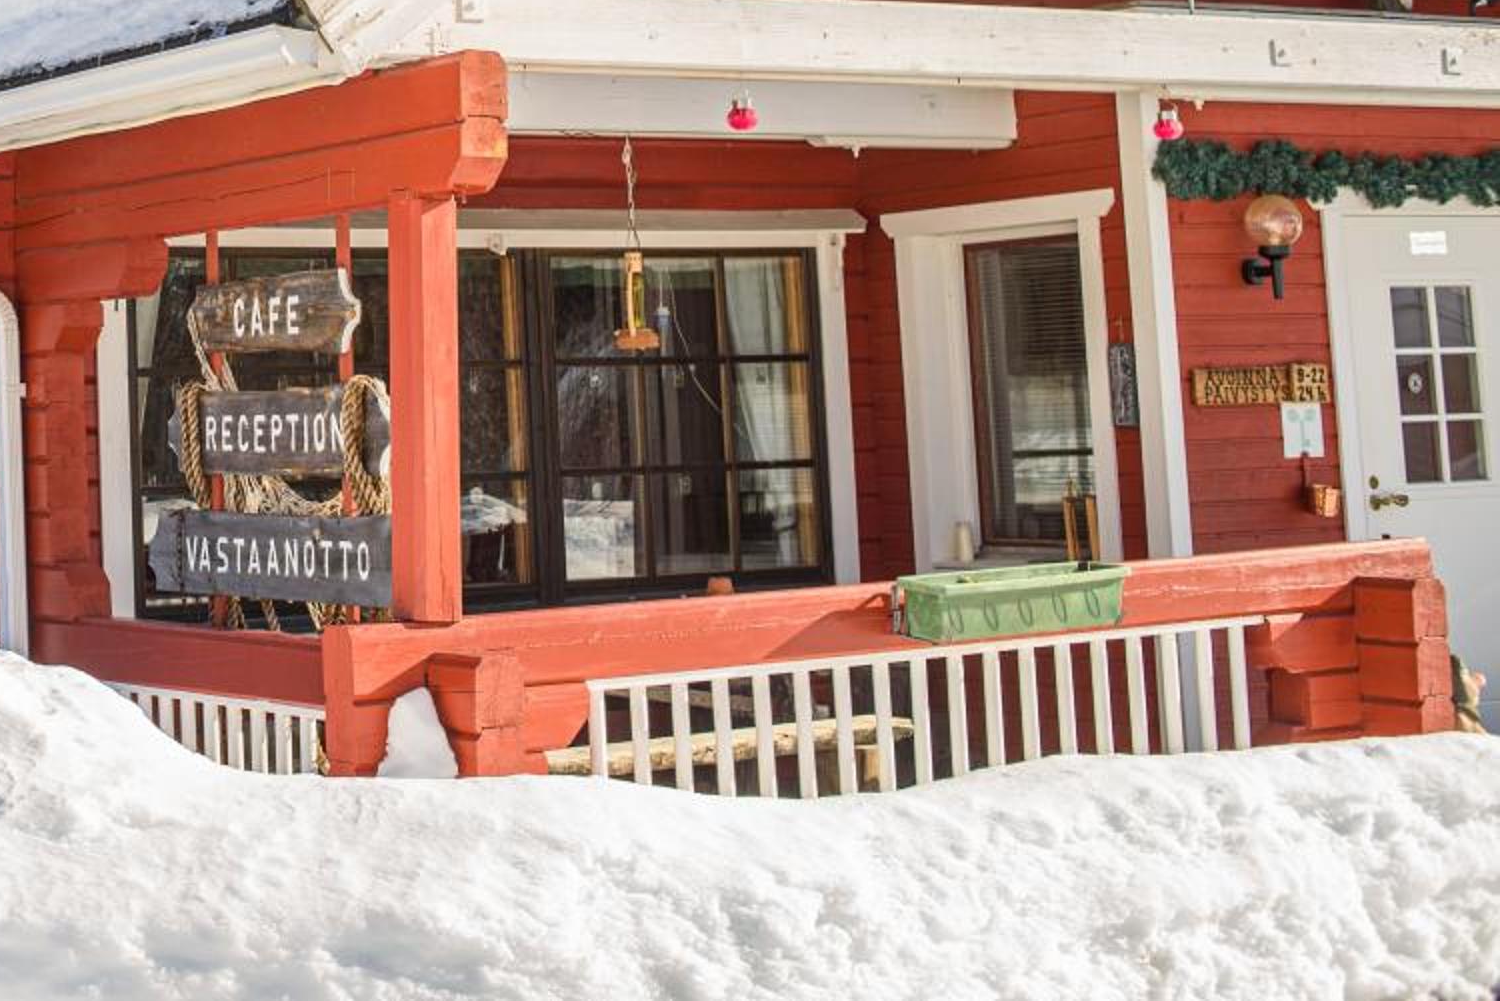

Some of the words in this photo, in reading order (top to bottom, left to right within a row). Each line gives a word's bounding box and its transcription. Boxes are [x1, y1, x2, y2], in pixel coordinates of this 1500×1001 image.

[233, 294, 300, 338] CAFE
[204, 411, 345, 454] RECEPTION
[185, 534, 371, 581] VASTAANOTTO
